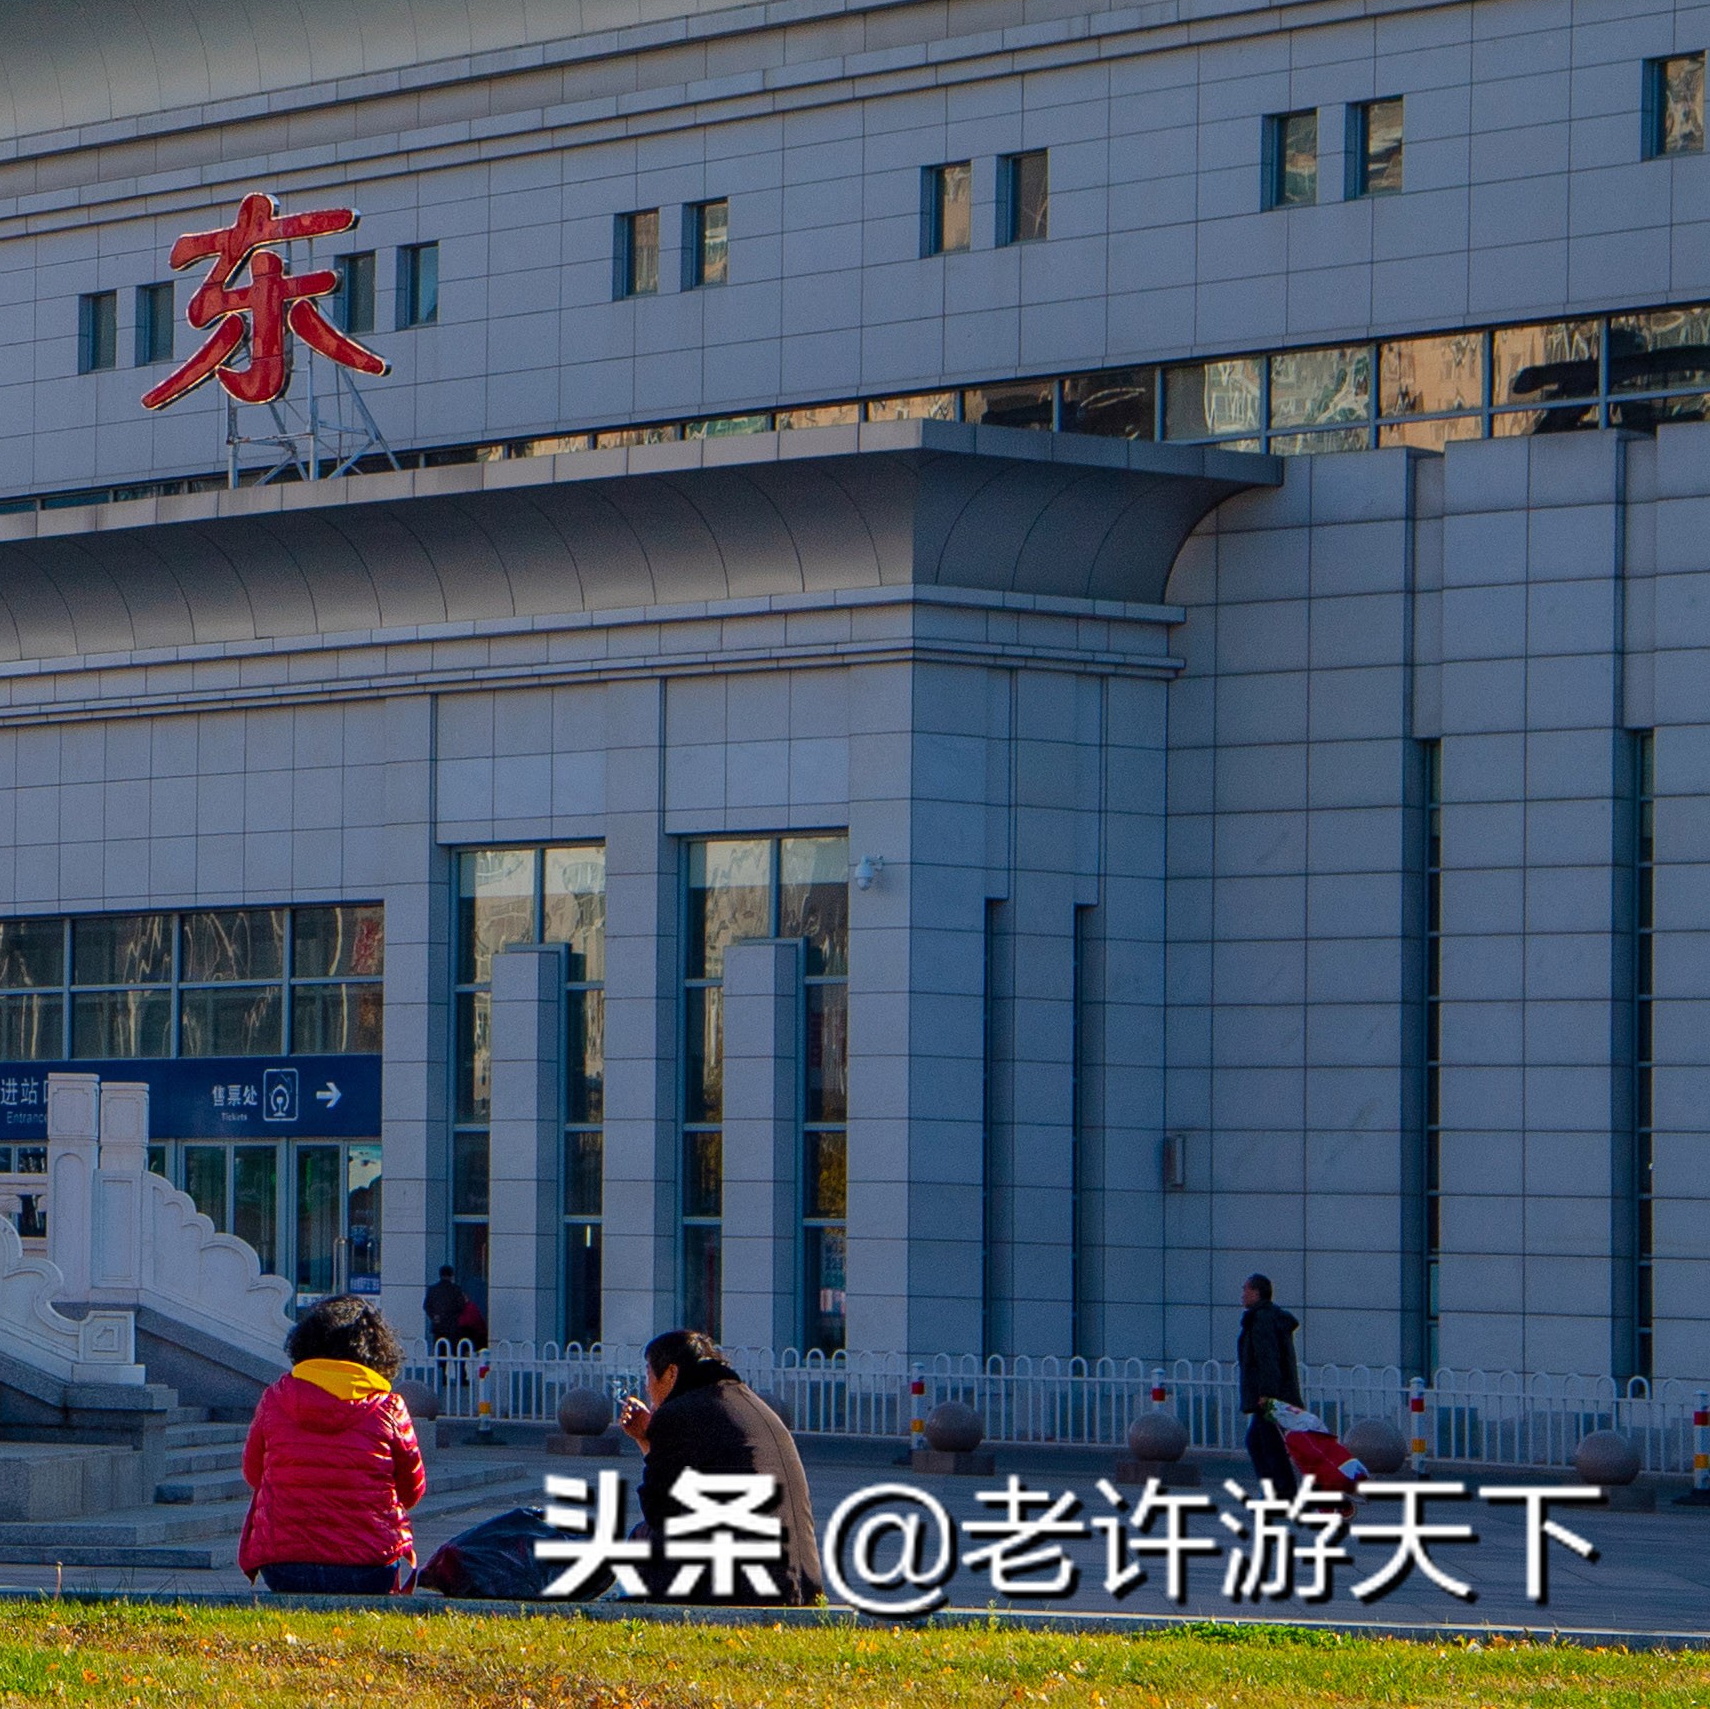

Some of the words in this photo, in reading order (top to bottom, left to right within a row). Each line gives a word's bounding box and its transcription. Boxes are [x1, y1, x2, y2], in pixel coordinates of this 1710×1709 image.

[212, 1084, 258, 1107] 售票处
[221, 1112, 248, 1122] Tickets
